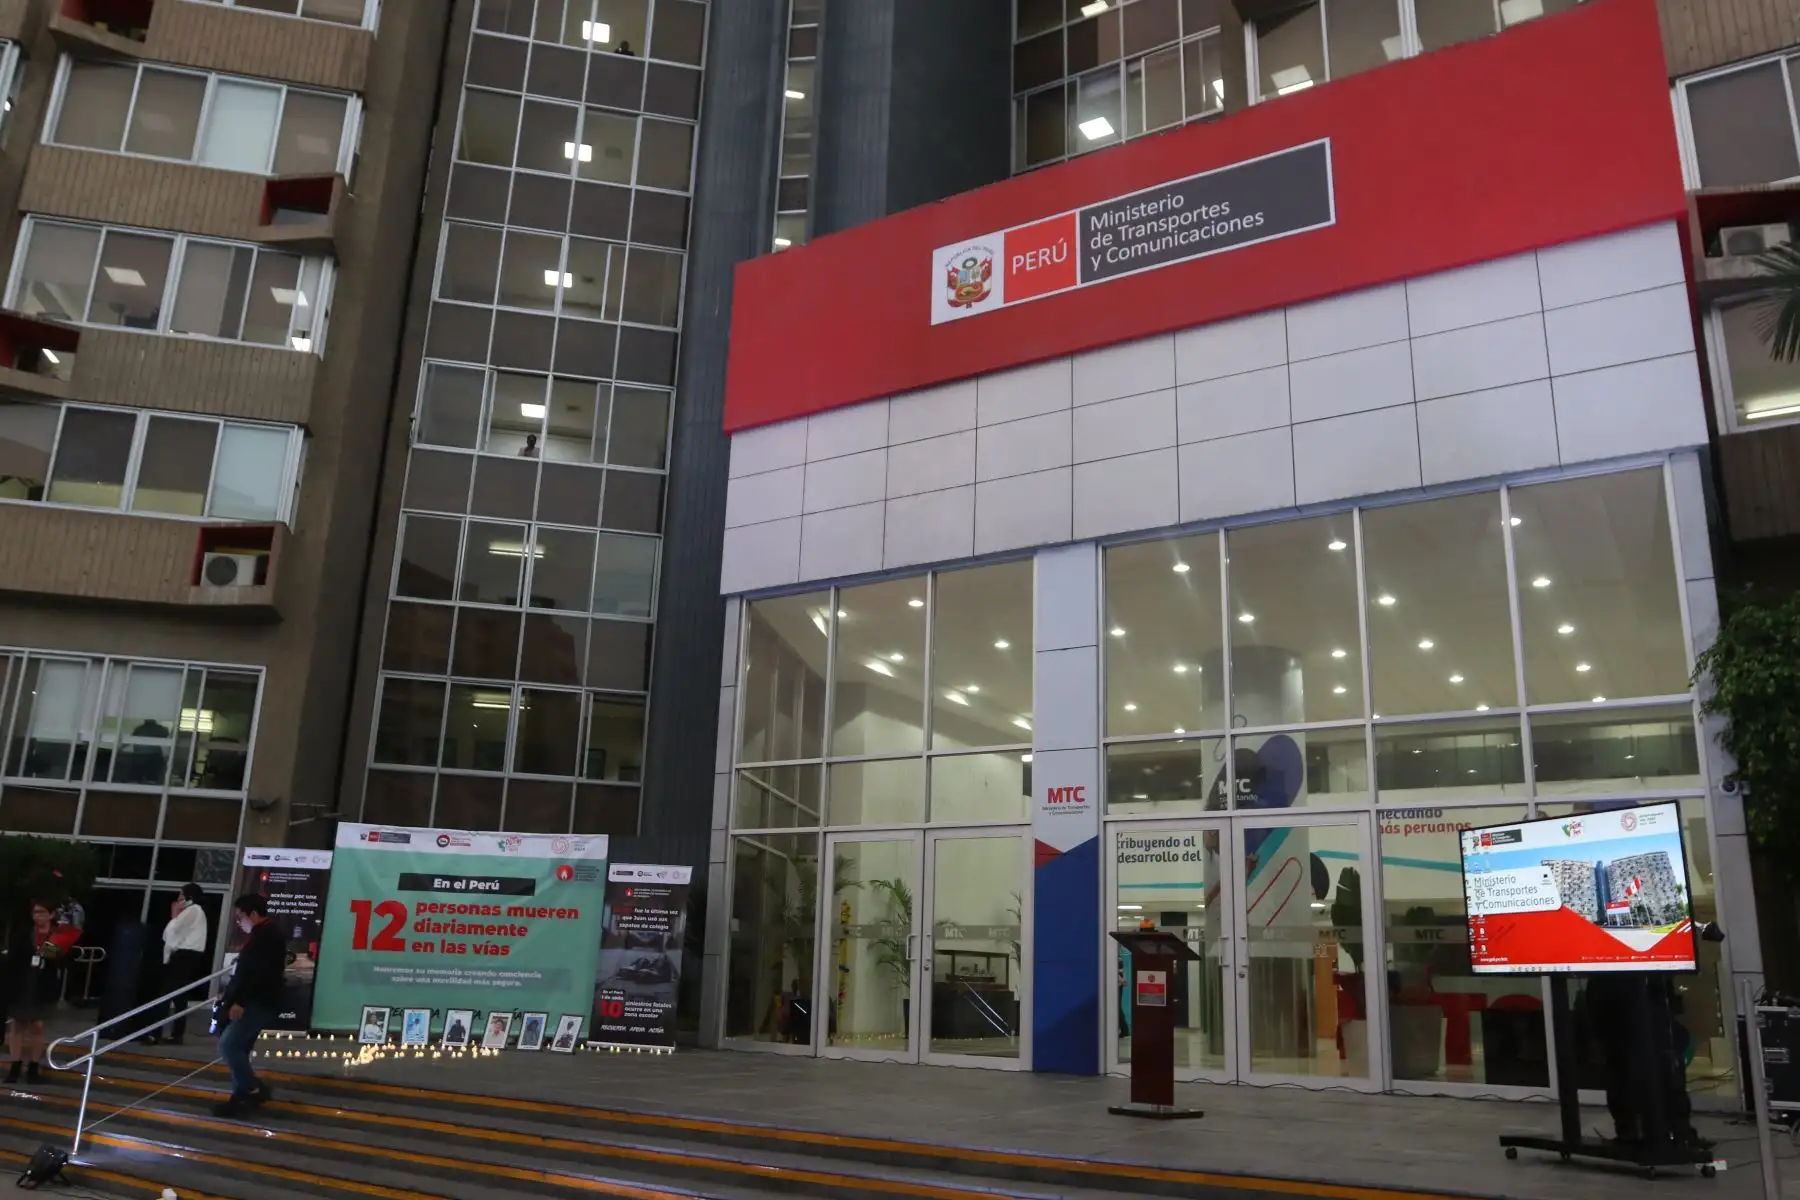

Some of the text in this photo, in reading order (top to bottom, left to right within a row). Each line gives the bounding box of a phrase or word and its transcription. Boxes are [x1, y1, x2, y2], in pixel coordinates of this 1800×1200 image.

[1090, 193, 1185, 232] Ministerio
[1090, 201, 1231, 250] de Transportes
[1091, 211, 1265, 272] y Comunicaciones
[1012, 237, 1067, 276] PERÚ
[1047, 786, 1085, 804] MTC
[1403, 821, 1473, 837] peruanos
[1183, 836, 1196, 848] al
[1117, 850, 1203, 864] desarrollo del
[433, 877, 500, 891] En el Perú
[1474, 874, 1517, 887] Ministerio
[1488, 885, 1539, 897] Transportes
[415, 901, 579, 920] personas mueren
[1482, 896, 1556, 910] Comunicaciones
[350, 899, 408, 952] 12
[413, 917, 529, 937] diariamente
[411, 939, 510, 956] en las vías
[600, 999, 623, 1018] 10
